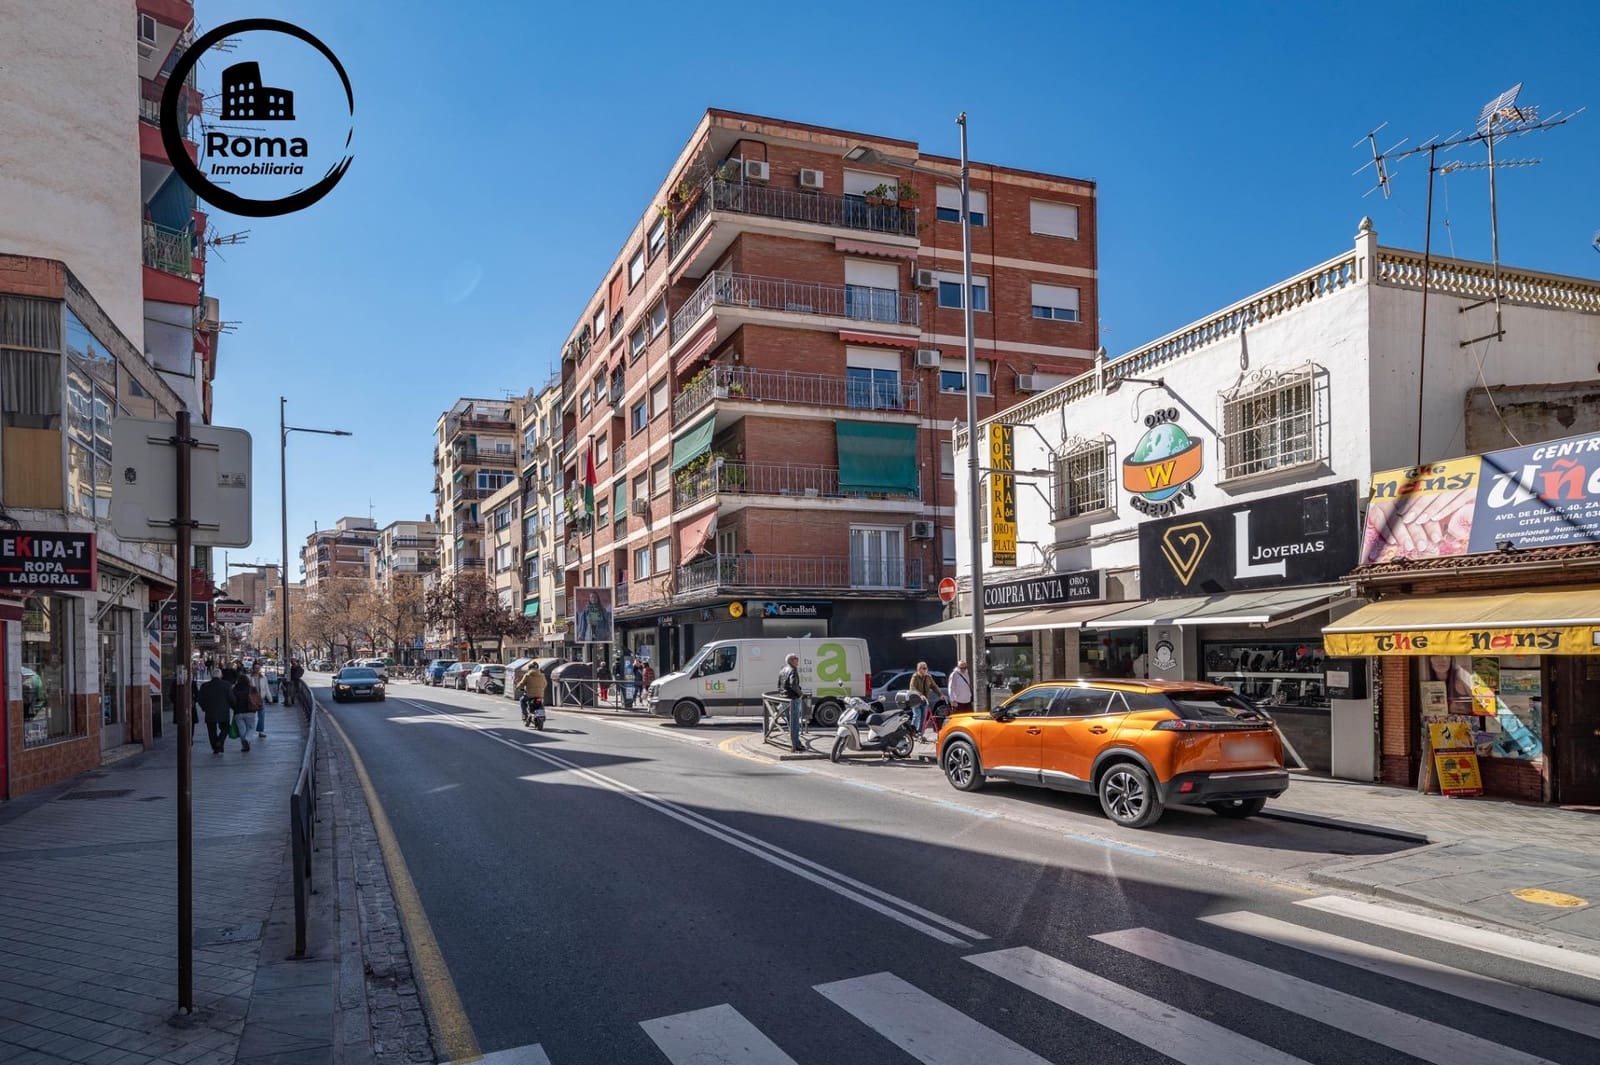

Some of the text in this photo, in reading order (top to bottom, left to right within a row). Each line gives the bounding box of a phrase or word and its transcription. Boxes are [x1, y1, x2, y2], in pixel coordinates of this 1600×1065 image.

[1144, 407, 1180, 428] ORO
[992, 426, 1002, 518] COMPRA
[1003, 428, 1013, 504] VENTA
[1144, 460, 1176, 489] W
[1130, 482, 1196, 518] CREDITY
[994, 523, 1008, 534] ORO
[1495, 523, 1598, 540] Extensiones humanas
[1520, 518, 1541, 526] CITA
[3, 536, 85, 559] EKIPA-T
[994, 540, 1014, 551] PLATA
[1232, 510, 1287, 580] L
[24, 561, 64, 573] ROPA
[9, 572, 79, 585] LABORAL
[1069, 576, 1084, 586] ORO
[984, 580, 1064, 606] COMPRA VENTA
[1069, 586, 1090, 596] PLATA
